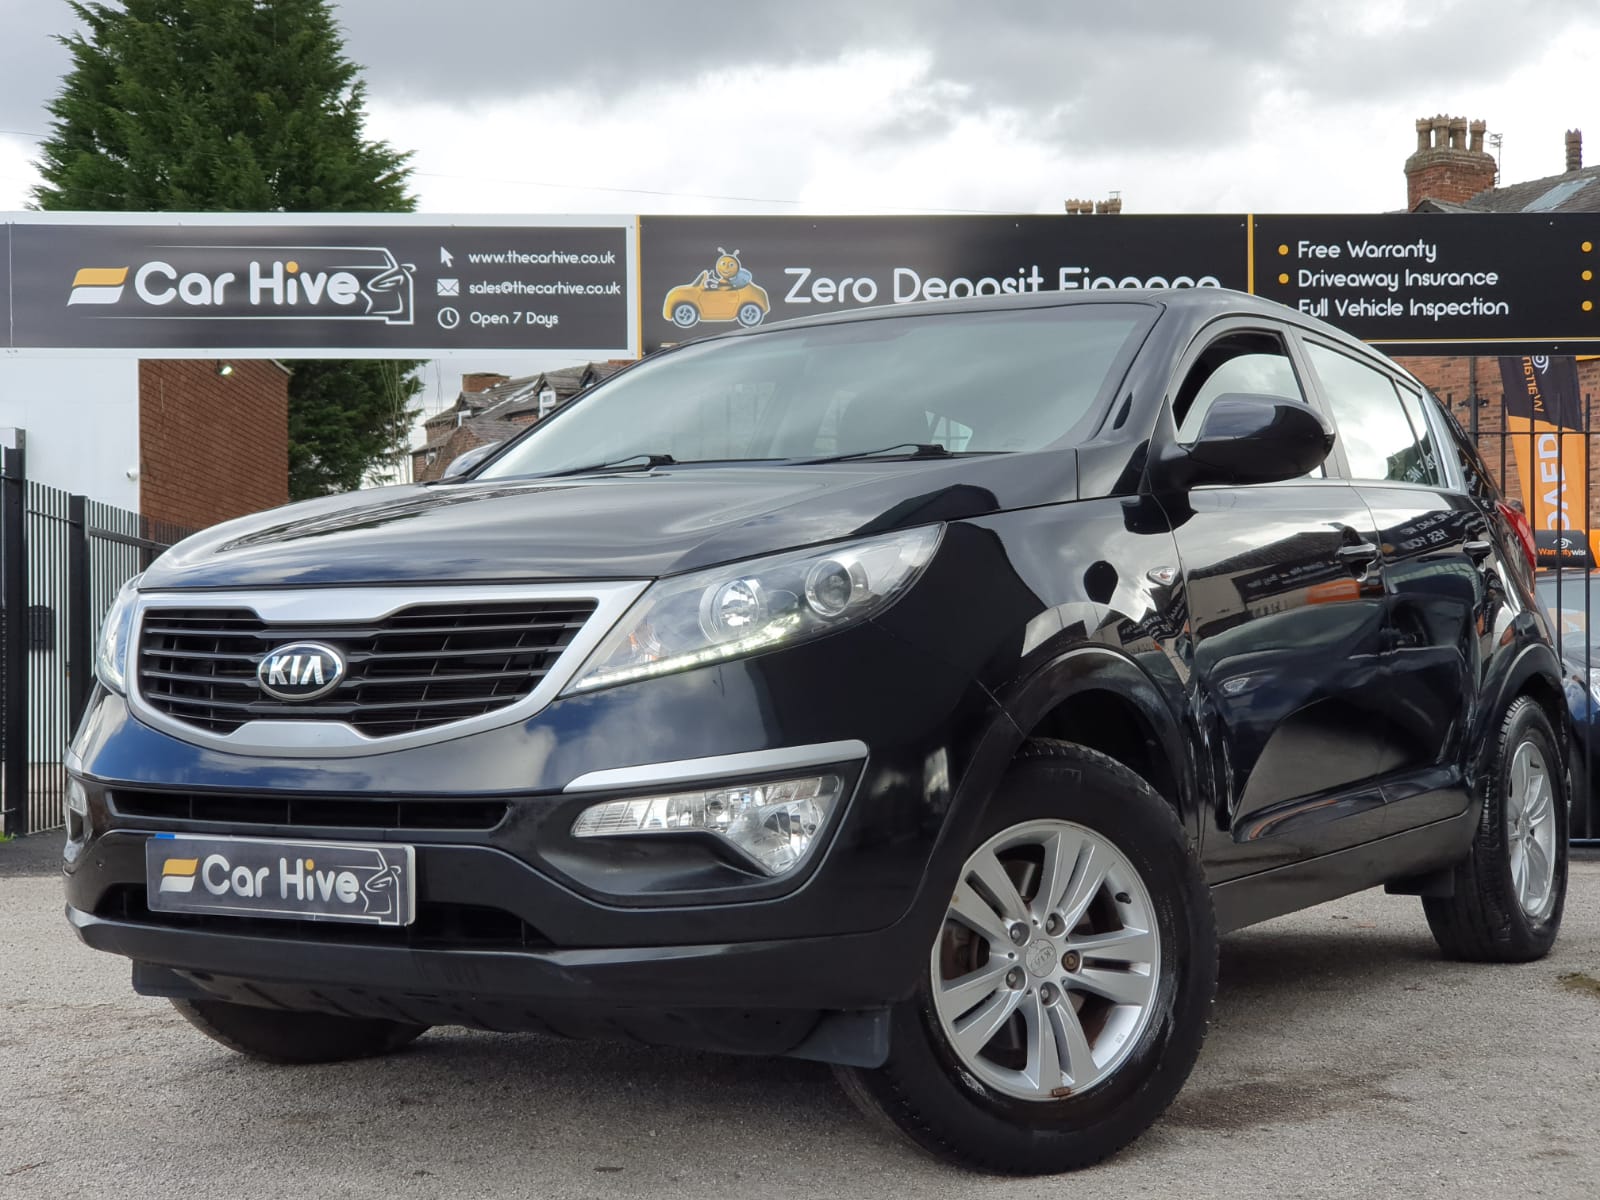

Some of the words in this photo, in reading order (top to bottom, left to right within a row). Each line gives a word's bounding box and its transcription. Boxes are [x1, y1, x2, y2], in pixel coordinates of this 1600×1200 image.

[468, 250, 616, 264] www.thecarhive.co.uk
[1298, 240, 1341, 259] Free
[1347, 239, 1436, 263] Warranty
[135, 261, 235, 305] Car
[250, 261, 361, 305] Hive
[469, 281, 621, 294] sales@thecarhive.co.uk
[784, 268, 878, 303] Zero
[1298, 269, 1398, 292] Driveaway
[1405, 269, 1499, 287] Insurance
[470, 312, 509, 327] Open
[513, 312, 521, 324] 7
[526, 312, 559, 328] Days
[1298, 298, 1328, 317] Full
[1335, 298, 1404, 316] Vehicle
[1410, 298, 1509, 321] Inspection
[268, 655, 324, 685] KIA
[202, 854, 270, 897] Car
[279, 857, 360, 903] Hive
